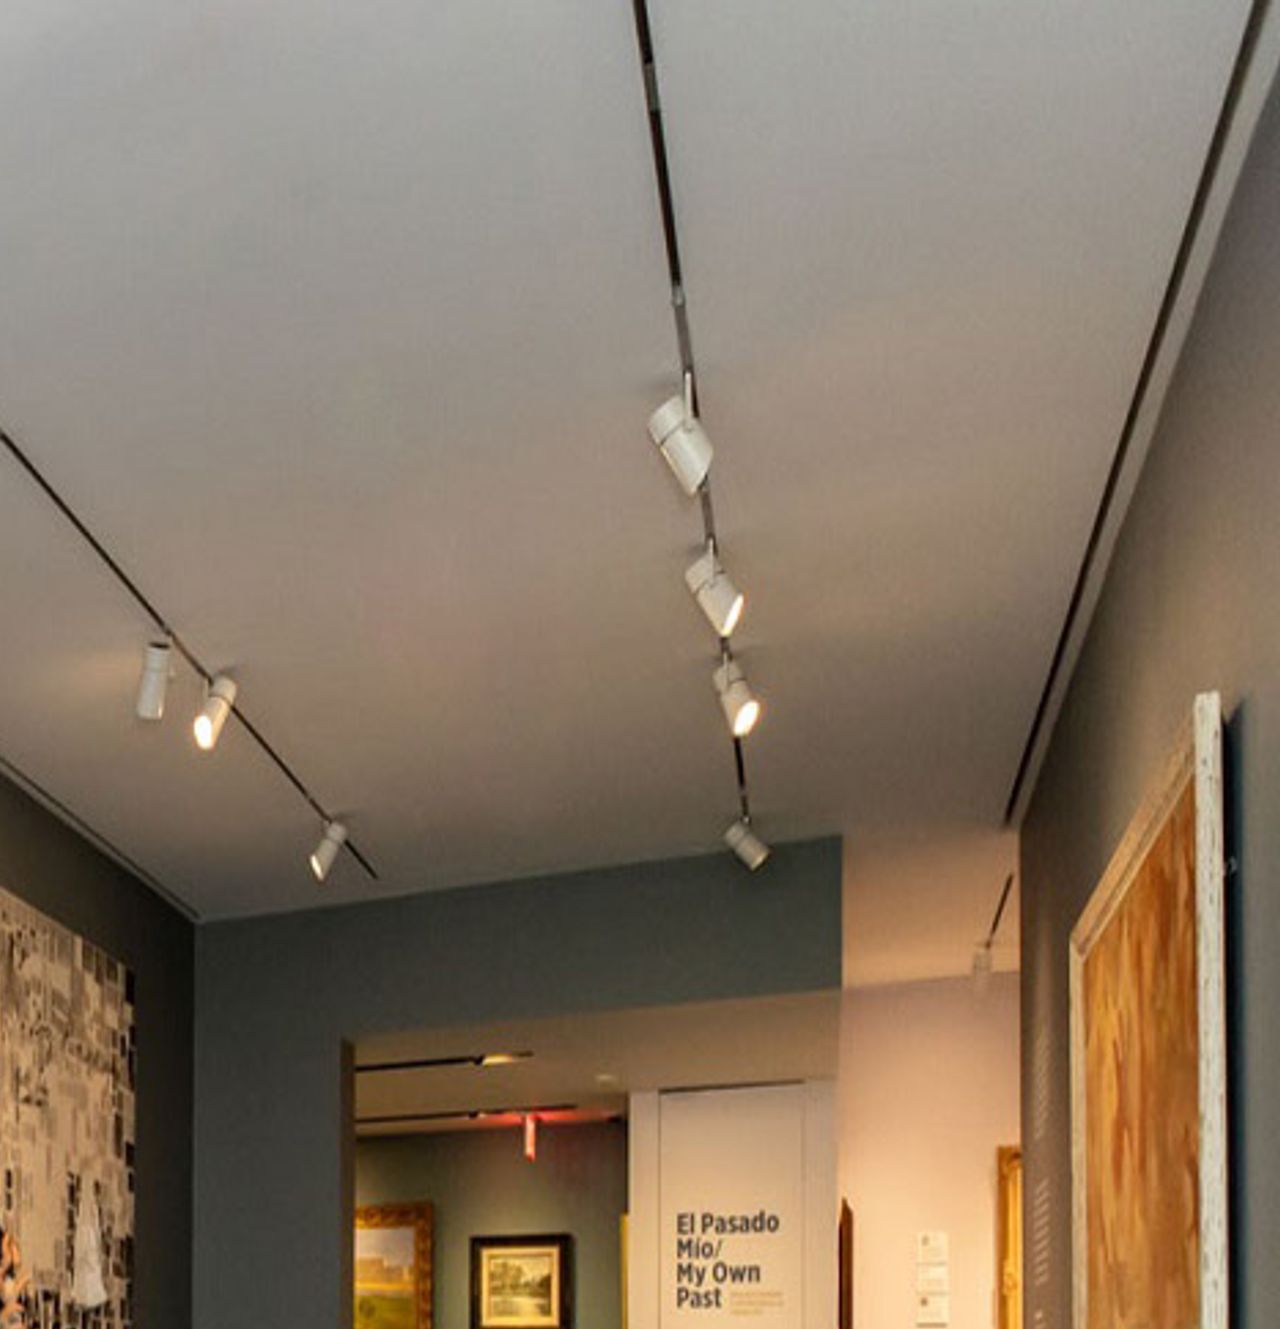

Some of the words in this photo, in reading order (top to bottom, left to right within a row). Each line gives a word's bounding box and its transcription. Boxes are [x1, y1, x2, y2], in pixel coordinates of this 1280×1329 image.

[677, 1213, 694, 1234] El
[701, 1210, 779, 1234] Pasado
[677, 1262, 705, 1287] My
[712, 1261, 760, 1283] Own
[677, 1287, 721, 1309] Past
